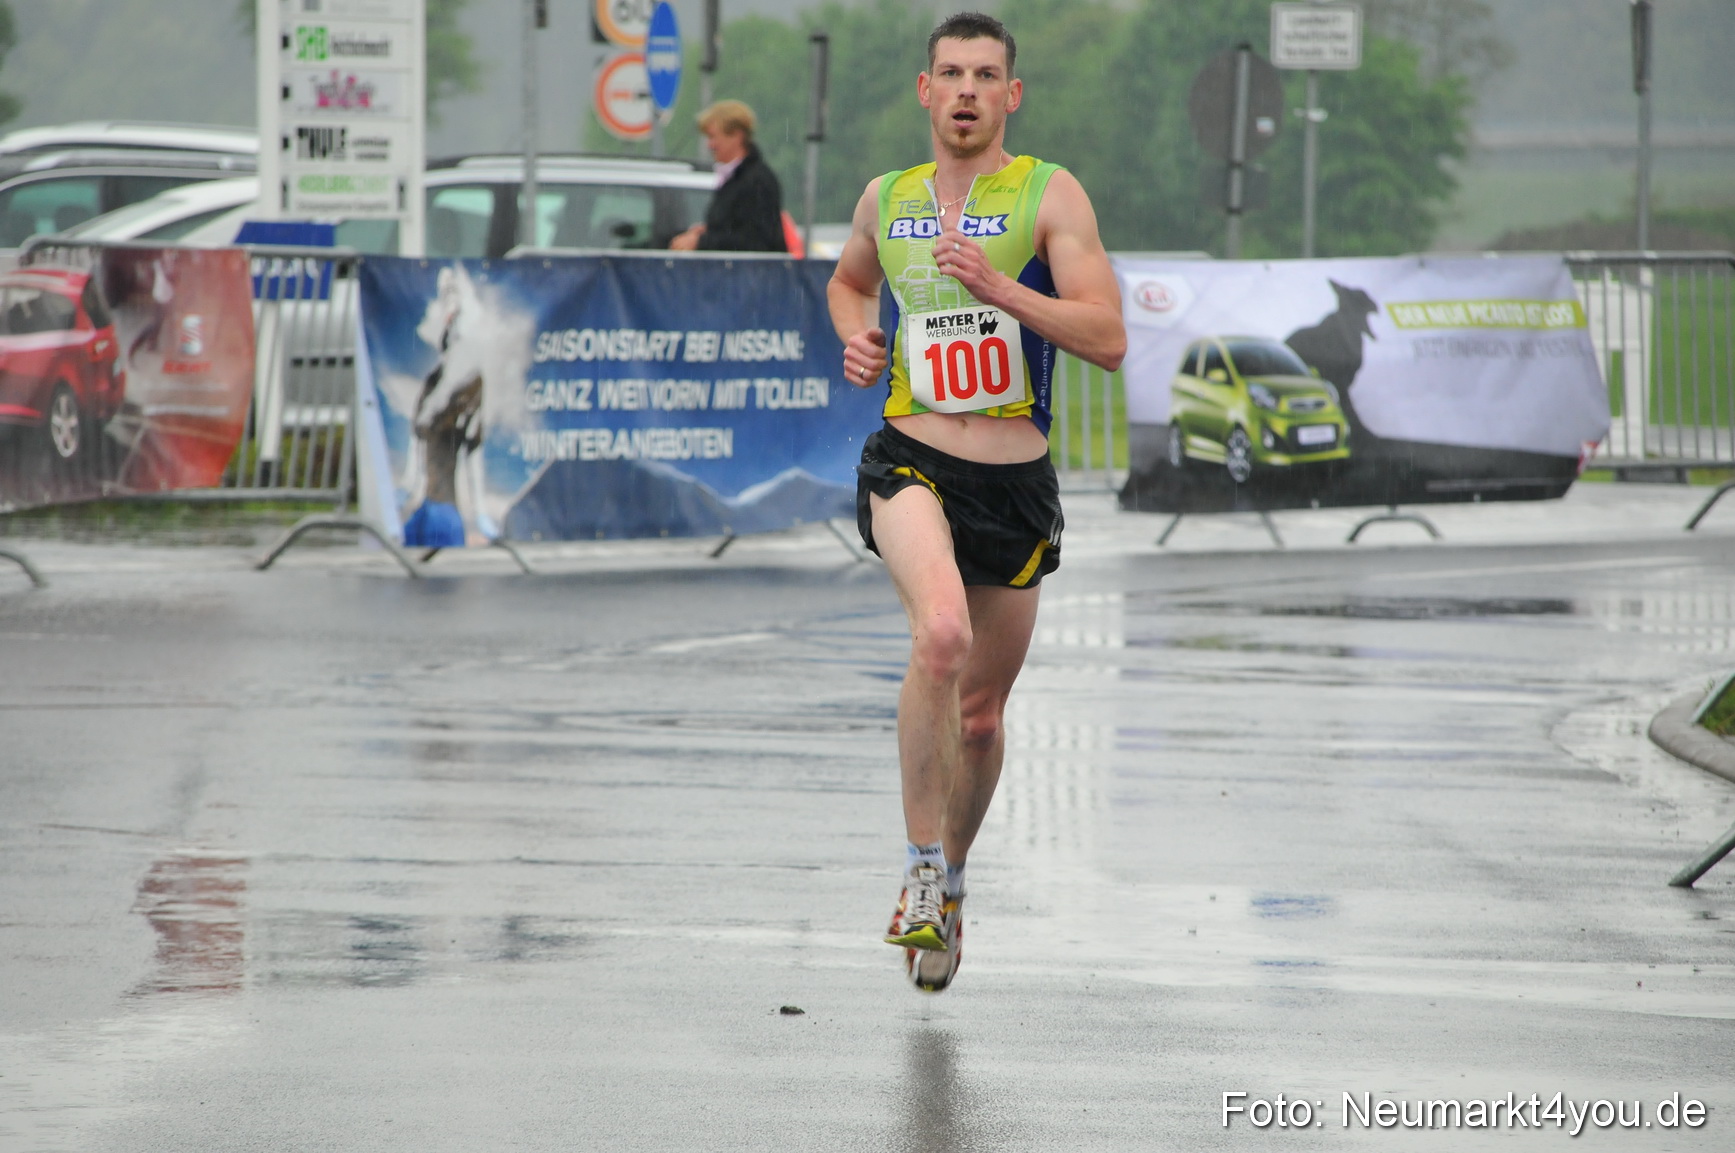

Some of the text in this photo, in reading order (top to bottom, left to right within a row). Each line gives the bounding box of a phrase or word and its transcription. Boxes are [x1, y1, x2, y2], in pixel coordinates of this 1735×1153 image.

[926, 313, 974, 330] MEYER
[926, 326, 976, 338] WERBUNG
[533, 328, 805, 363] SAISONSTART BEI NISSAN:
[925, 336, 1011, 402] 100
[527, 379, 593, 411] GANZ
[649, 378, 712, 411] VORN
[712, 378, 750, 409] MIT
[752, 377, 830, 408] TOLLEN
[520, 428, 734, 461] WINTERANGEBOTEN
